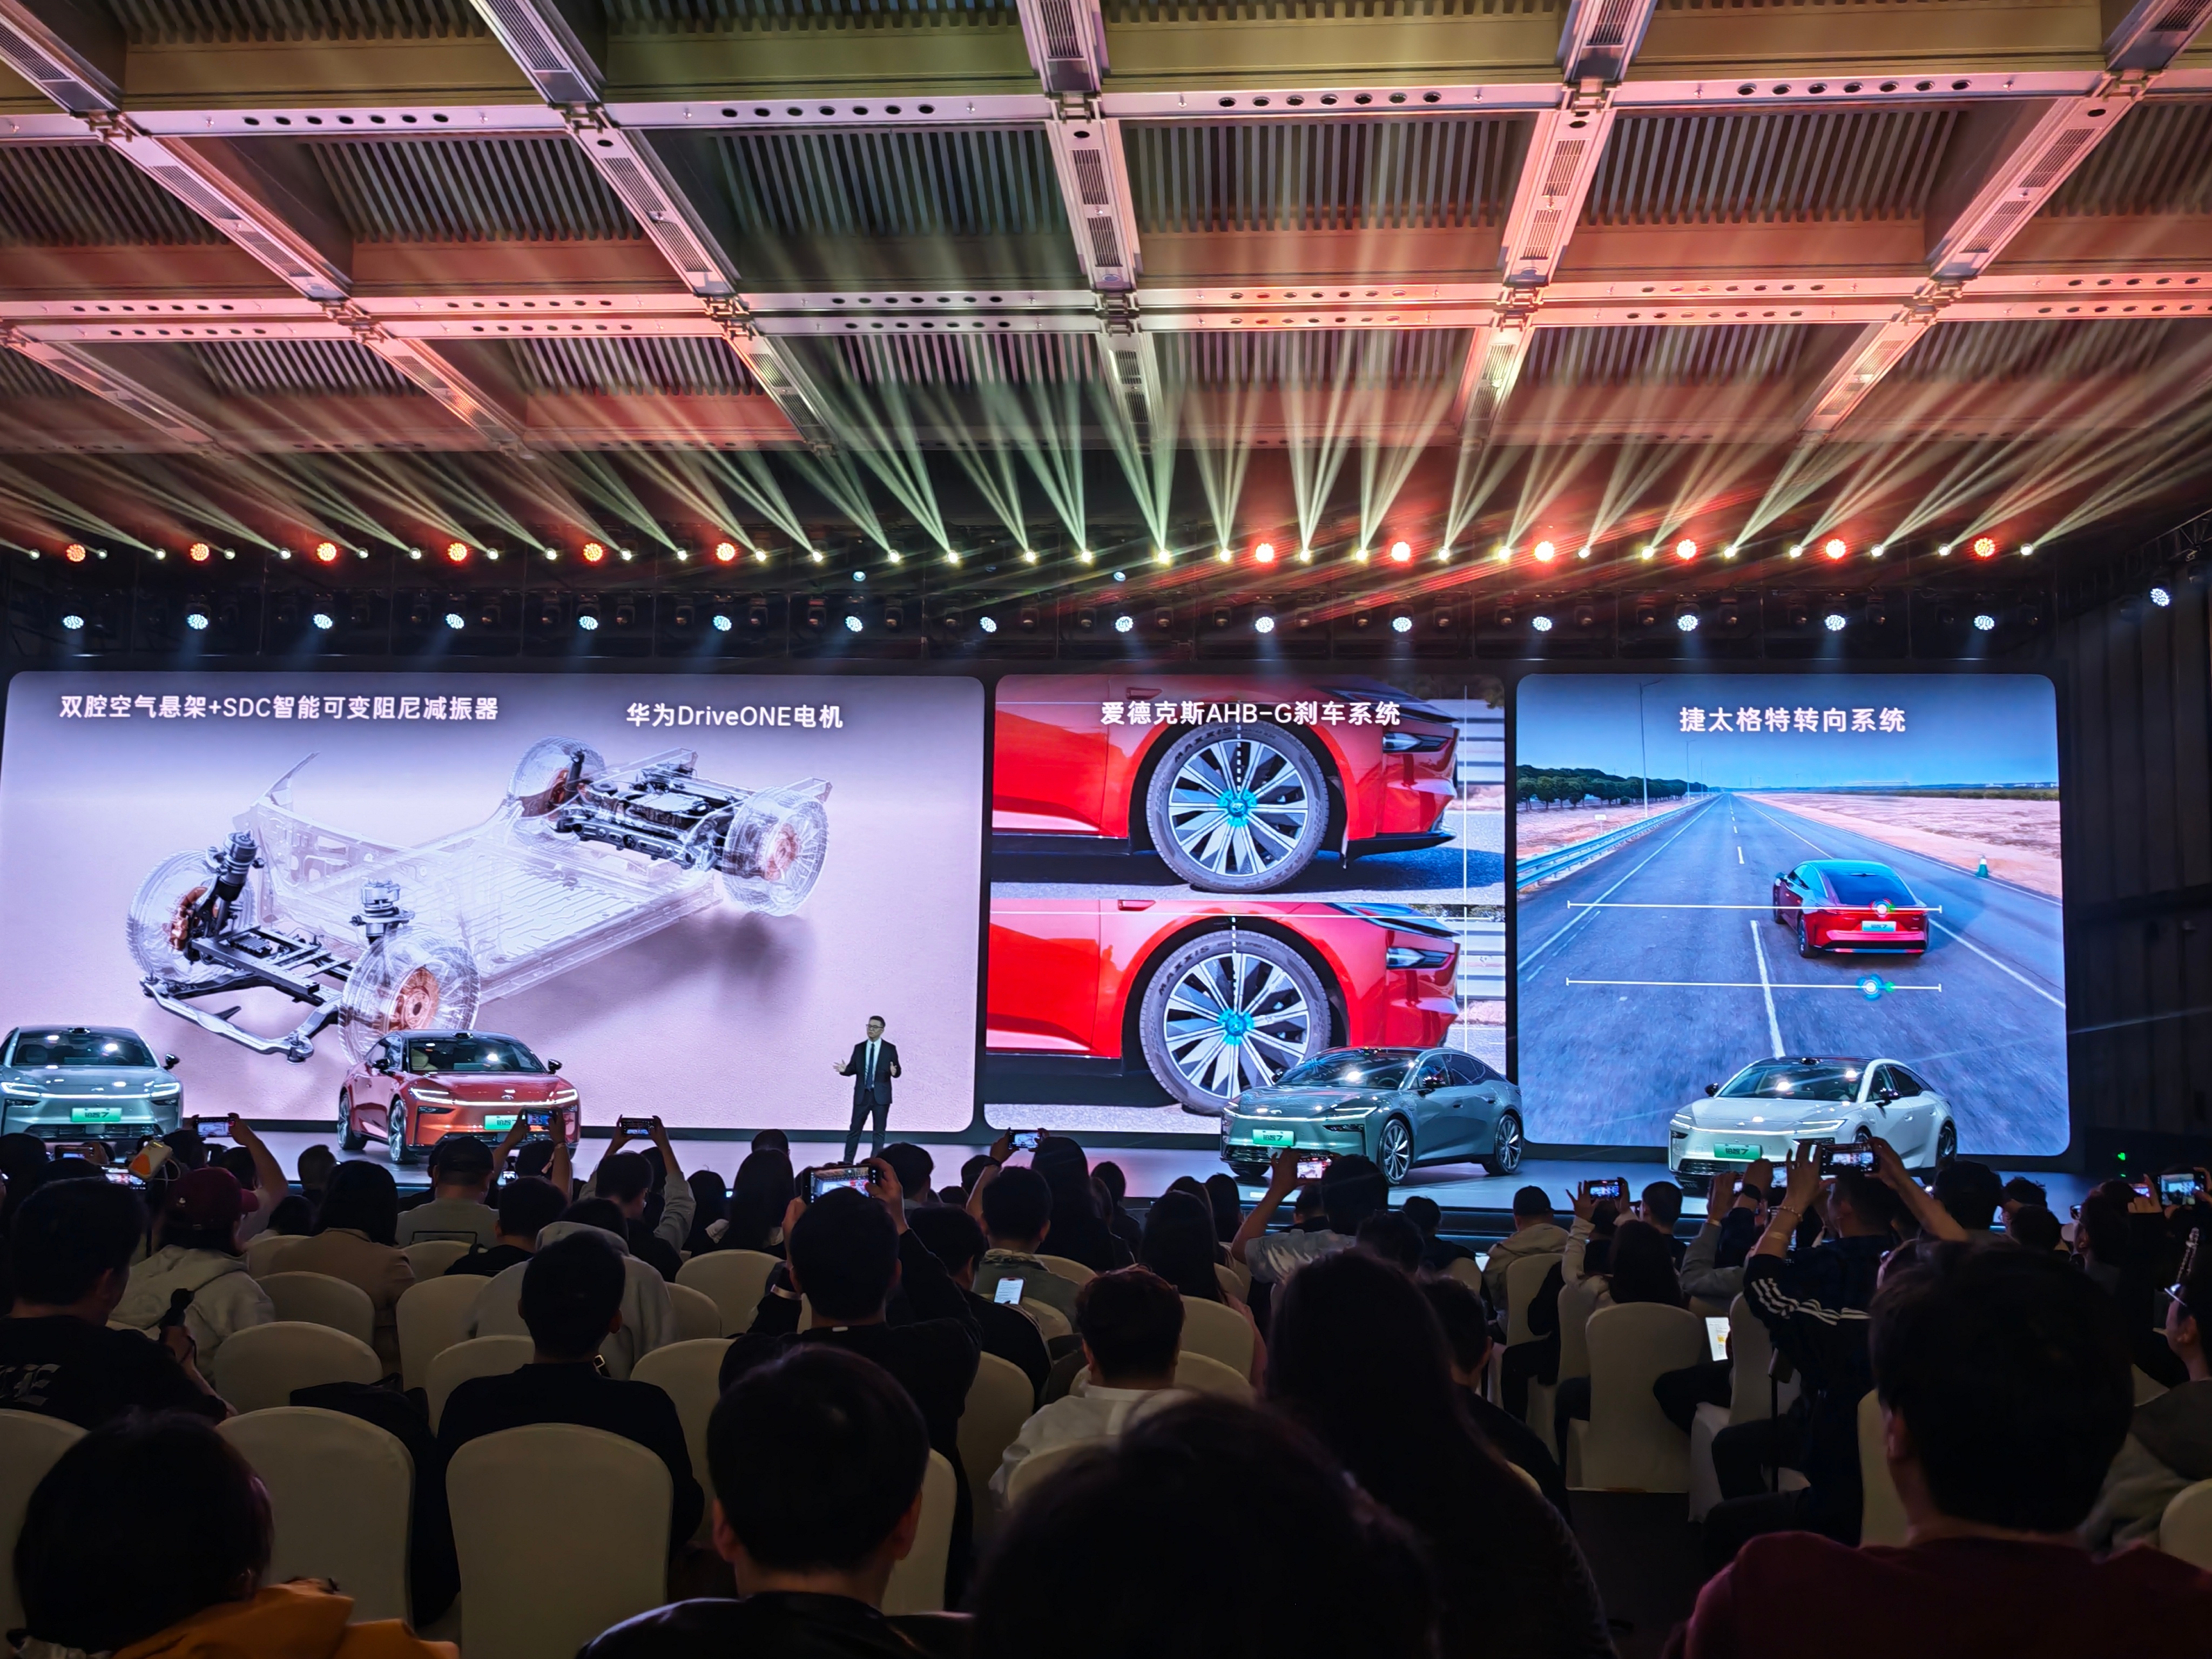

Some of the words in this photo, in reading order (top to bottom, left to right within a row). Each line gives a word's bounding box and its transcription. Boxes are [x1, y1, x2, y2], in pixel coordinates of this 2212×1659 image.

[59, 694, 498, 720] 双腔空气悬架+SDC智能可变阻尼减振器
[626, 703, 844, 729] 华为DriveONE电机
[1100, 700, 1400, 725] 爱德克斯AHB-G刹车系统
[1680, 707, 1906, 732] 捷太格特转向系统
[1174, 727, 1232, 763] MAXXIS
[1158, 945, 1210, 996] MAXXIS
